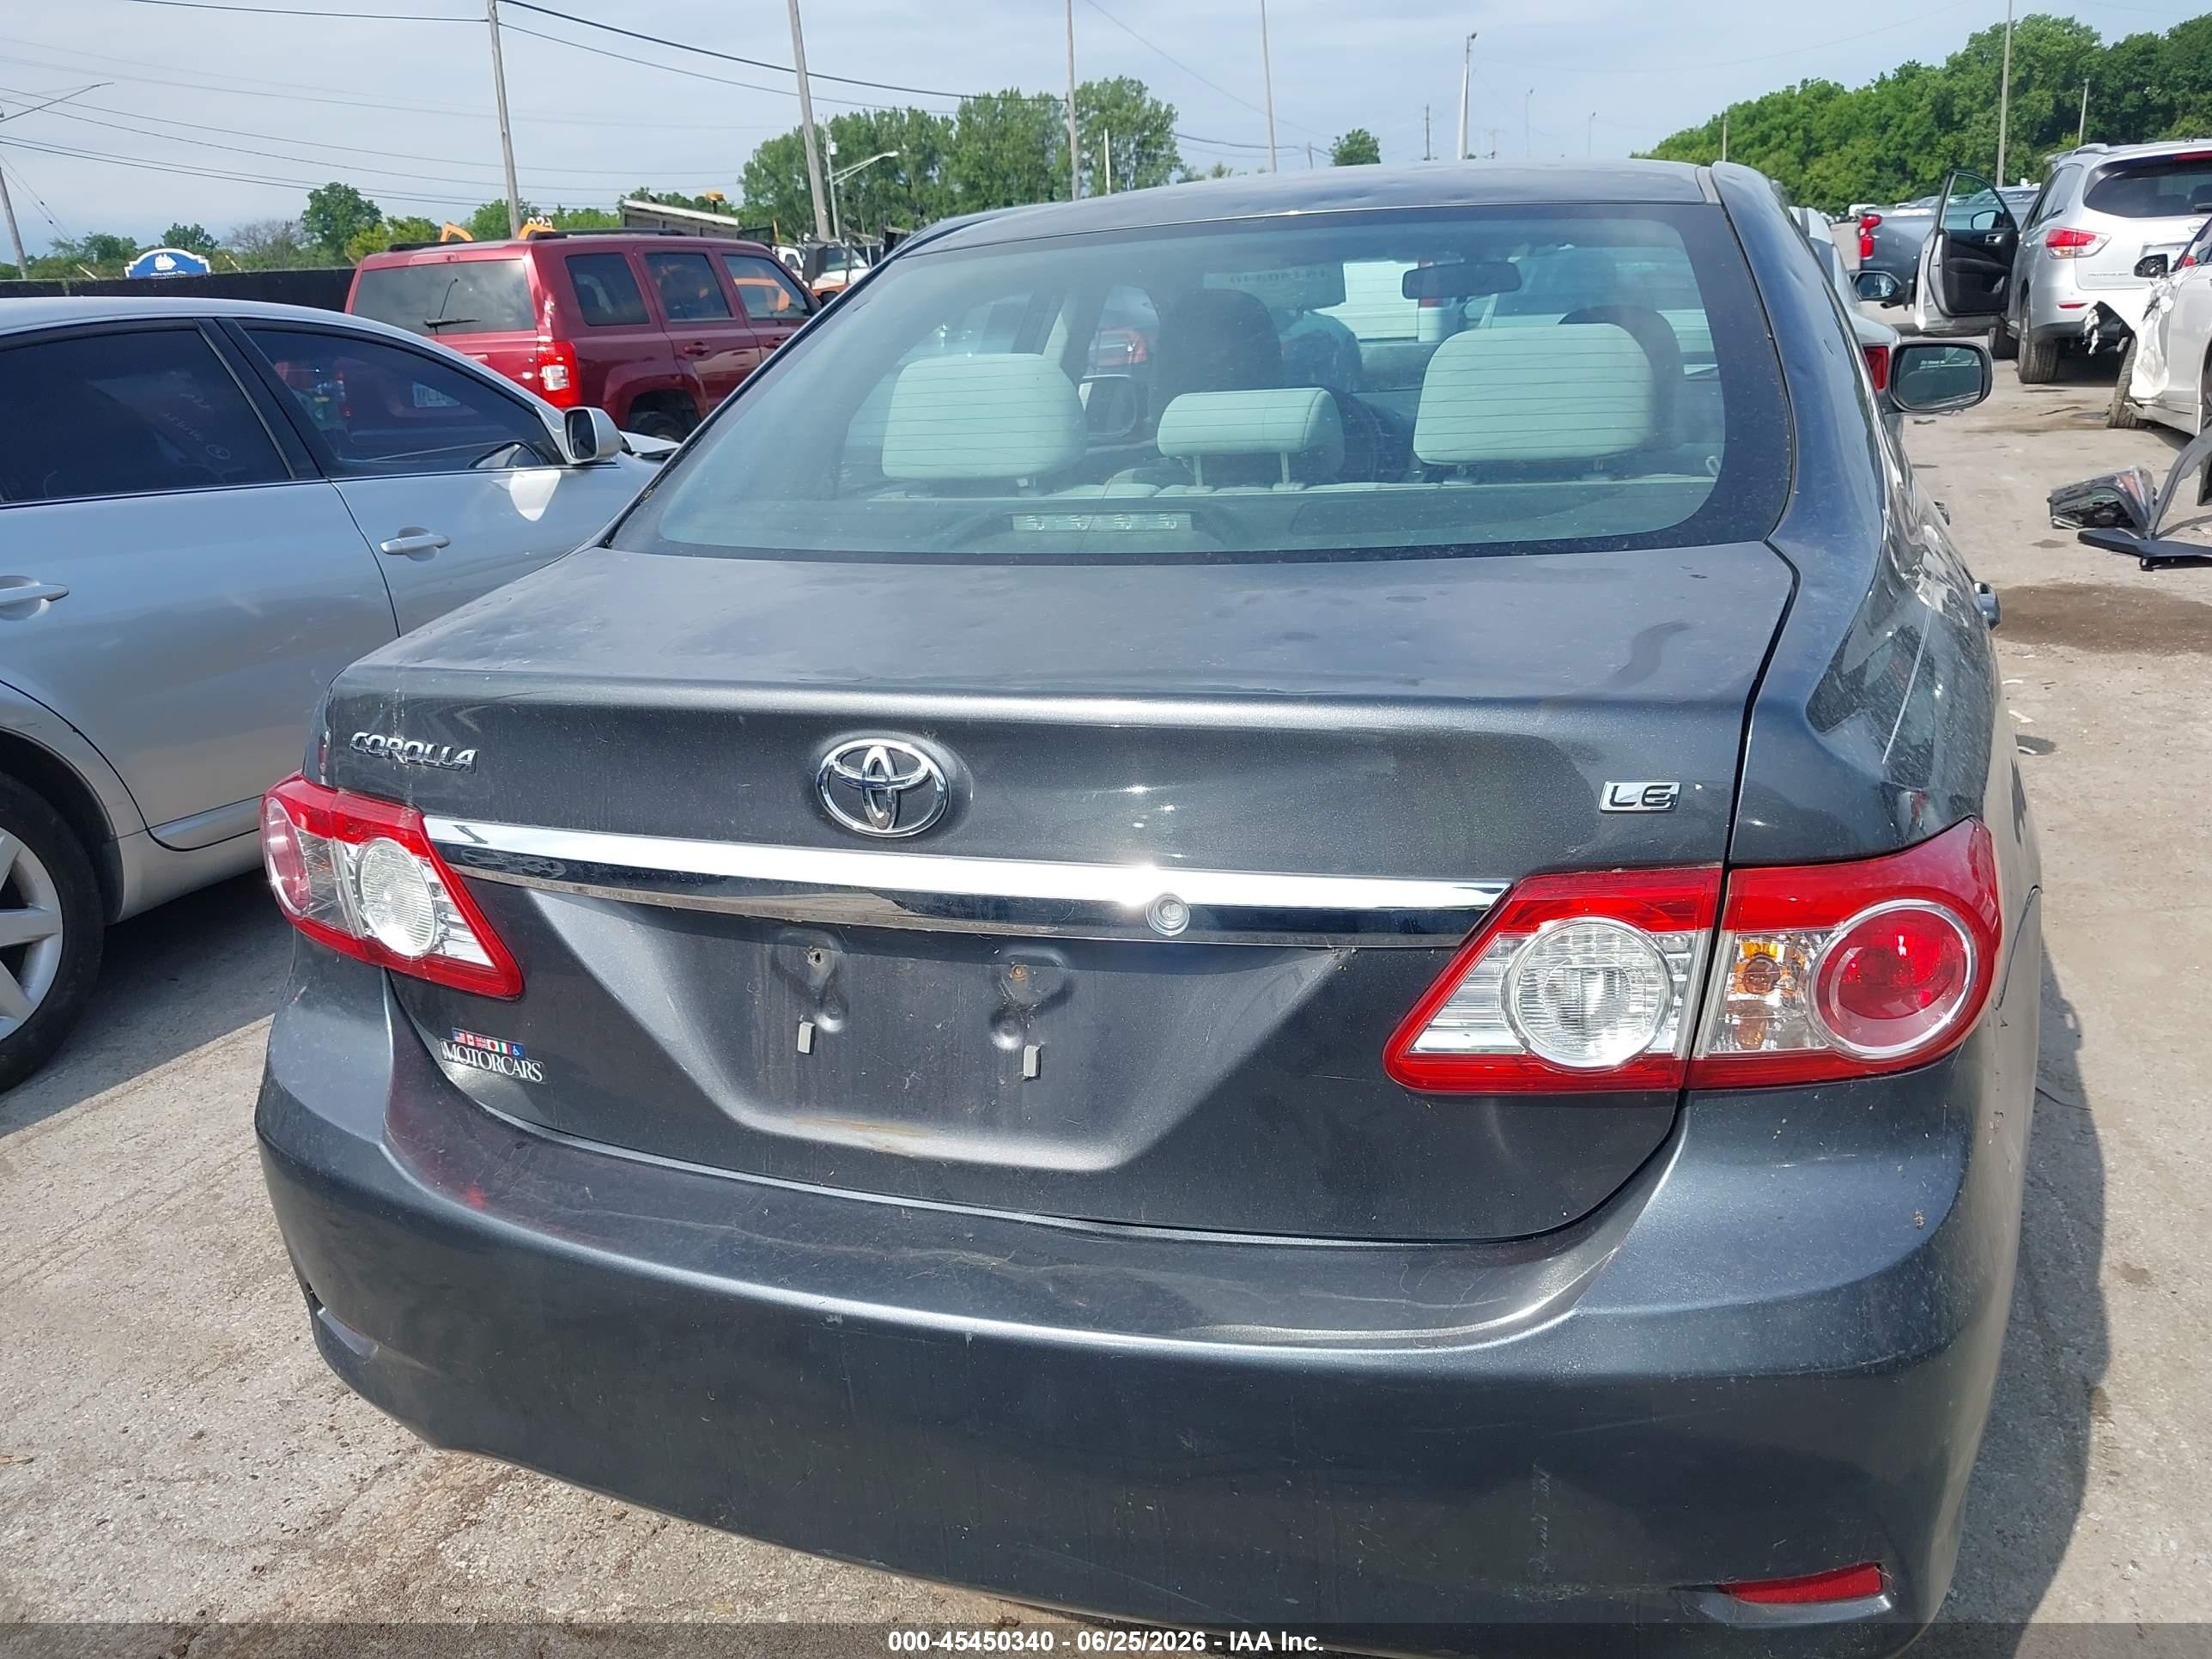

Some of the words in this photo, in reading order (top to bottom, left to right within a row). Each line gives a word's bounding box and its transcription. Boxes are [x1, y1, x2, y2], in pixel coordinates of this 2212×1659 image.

[350, 732, 477, 773] COROLLA
[1608, 785, 1674, 808] LE
[440, 1041, 543, 1083] MOTORCARS
